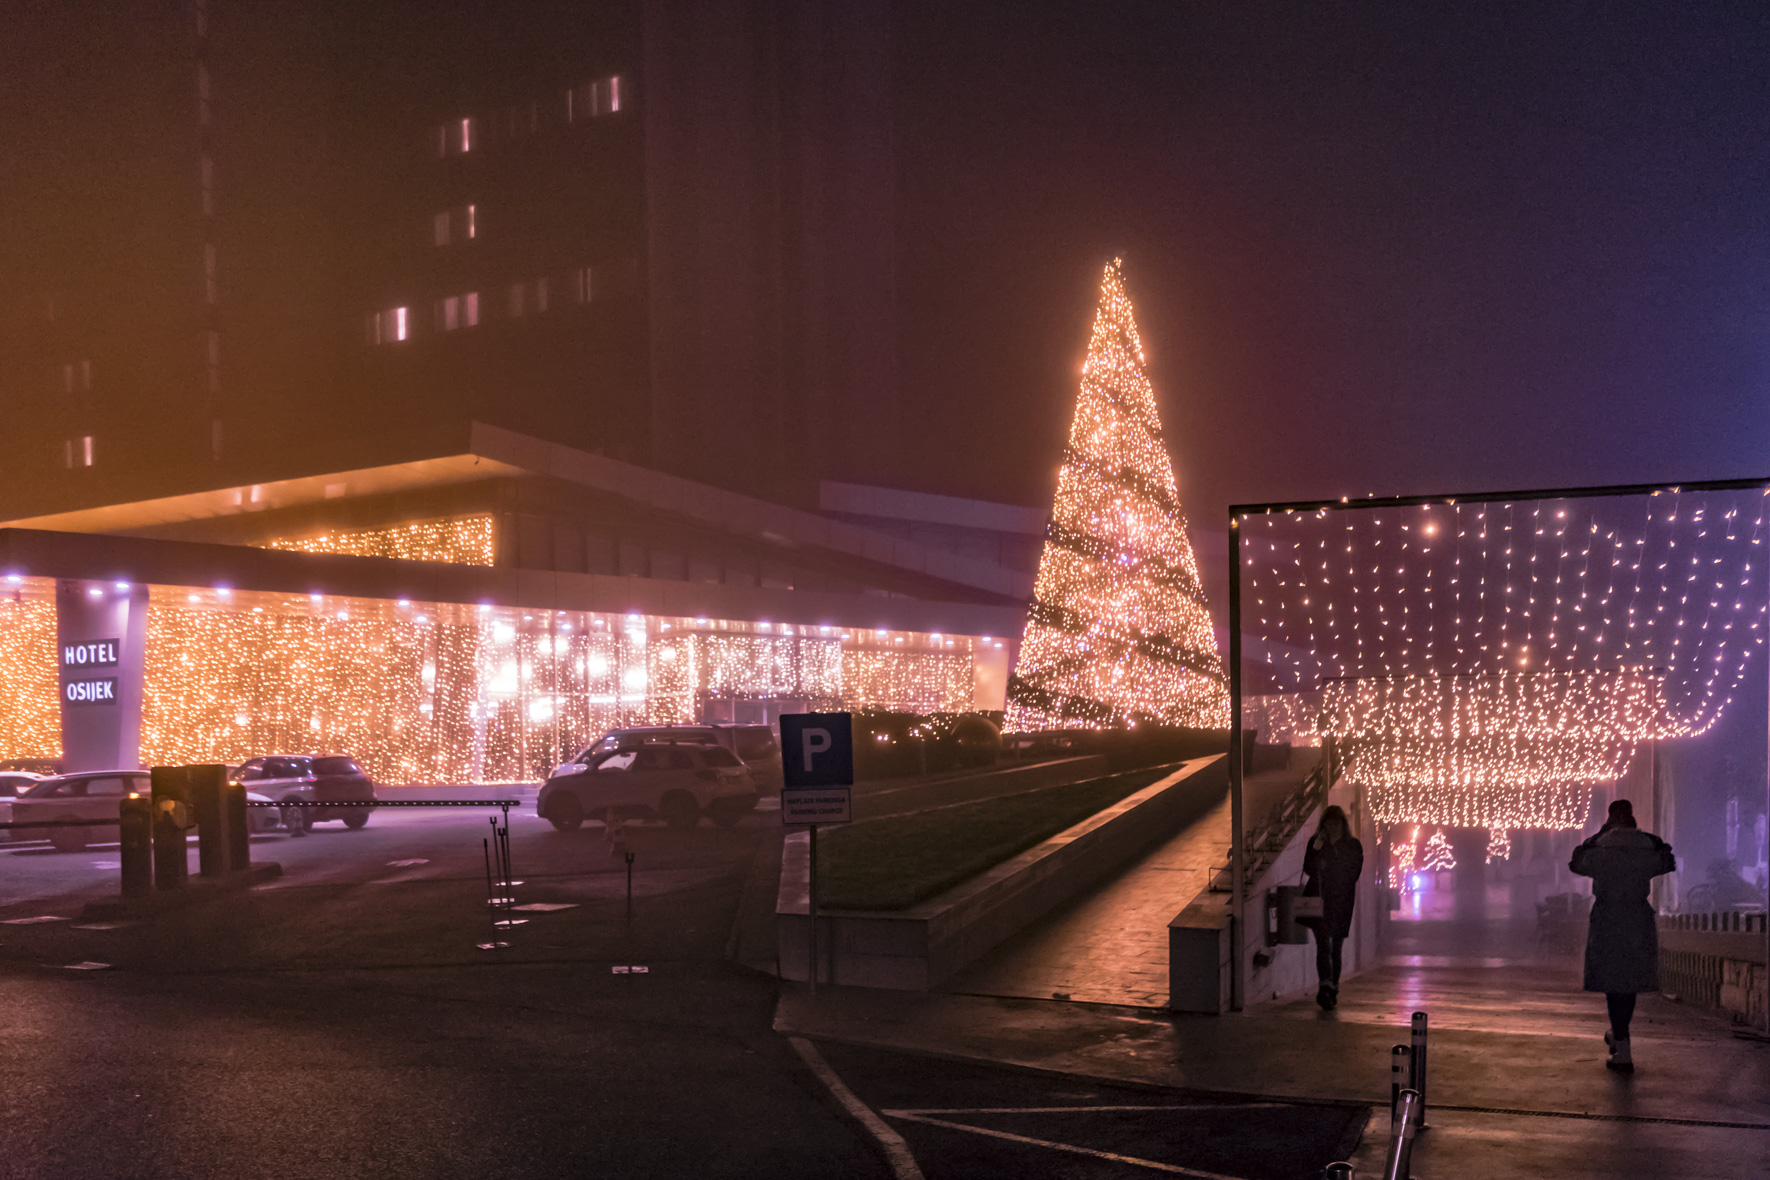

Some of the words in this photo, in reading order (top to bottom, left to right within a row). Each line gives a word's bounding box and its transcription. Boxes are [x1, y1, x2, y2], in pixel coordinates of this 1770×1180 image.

[65, 643, 117, 665] HOTEL
[66, 681, 114, 702] OSIJEK
[802, 727, 832, 772] P
[818, 807, 843, 815] CHARGE
